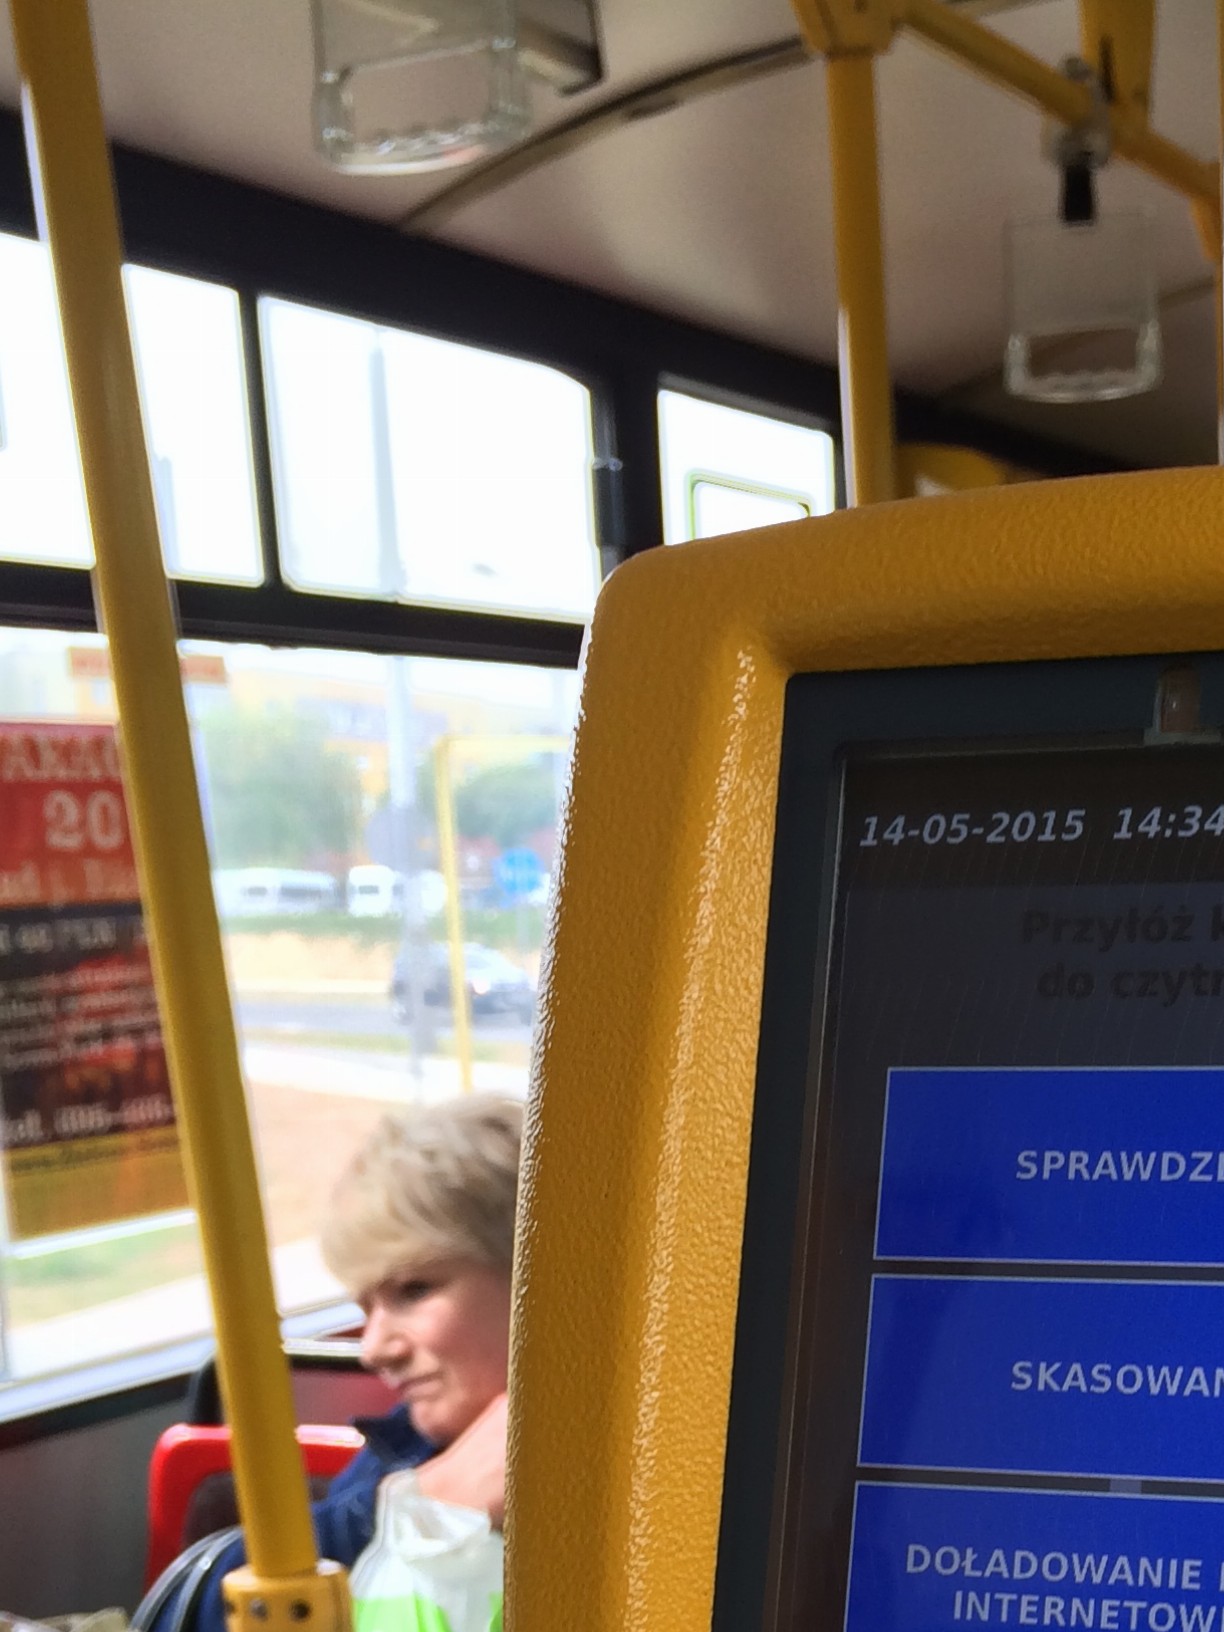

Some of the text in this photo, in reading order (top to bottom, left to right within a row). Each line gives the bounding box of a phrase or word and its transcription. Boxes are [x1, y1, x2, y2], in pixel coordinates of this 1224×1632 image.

[860, 809, 1086, 847] 14-05-2015
[1021, 904, 1196, 951] Przyłóż
[1036, 961, 1095, 998] do
[905, 1543, 1202, 1592] DOŁADOWANIE
